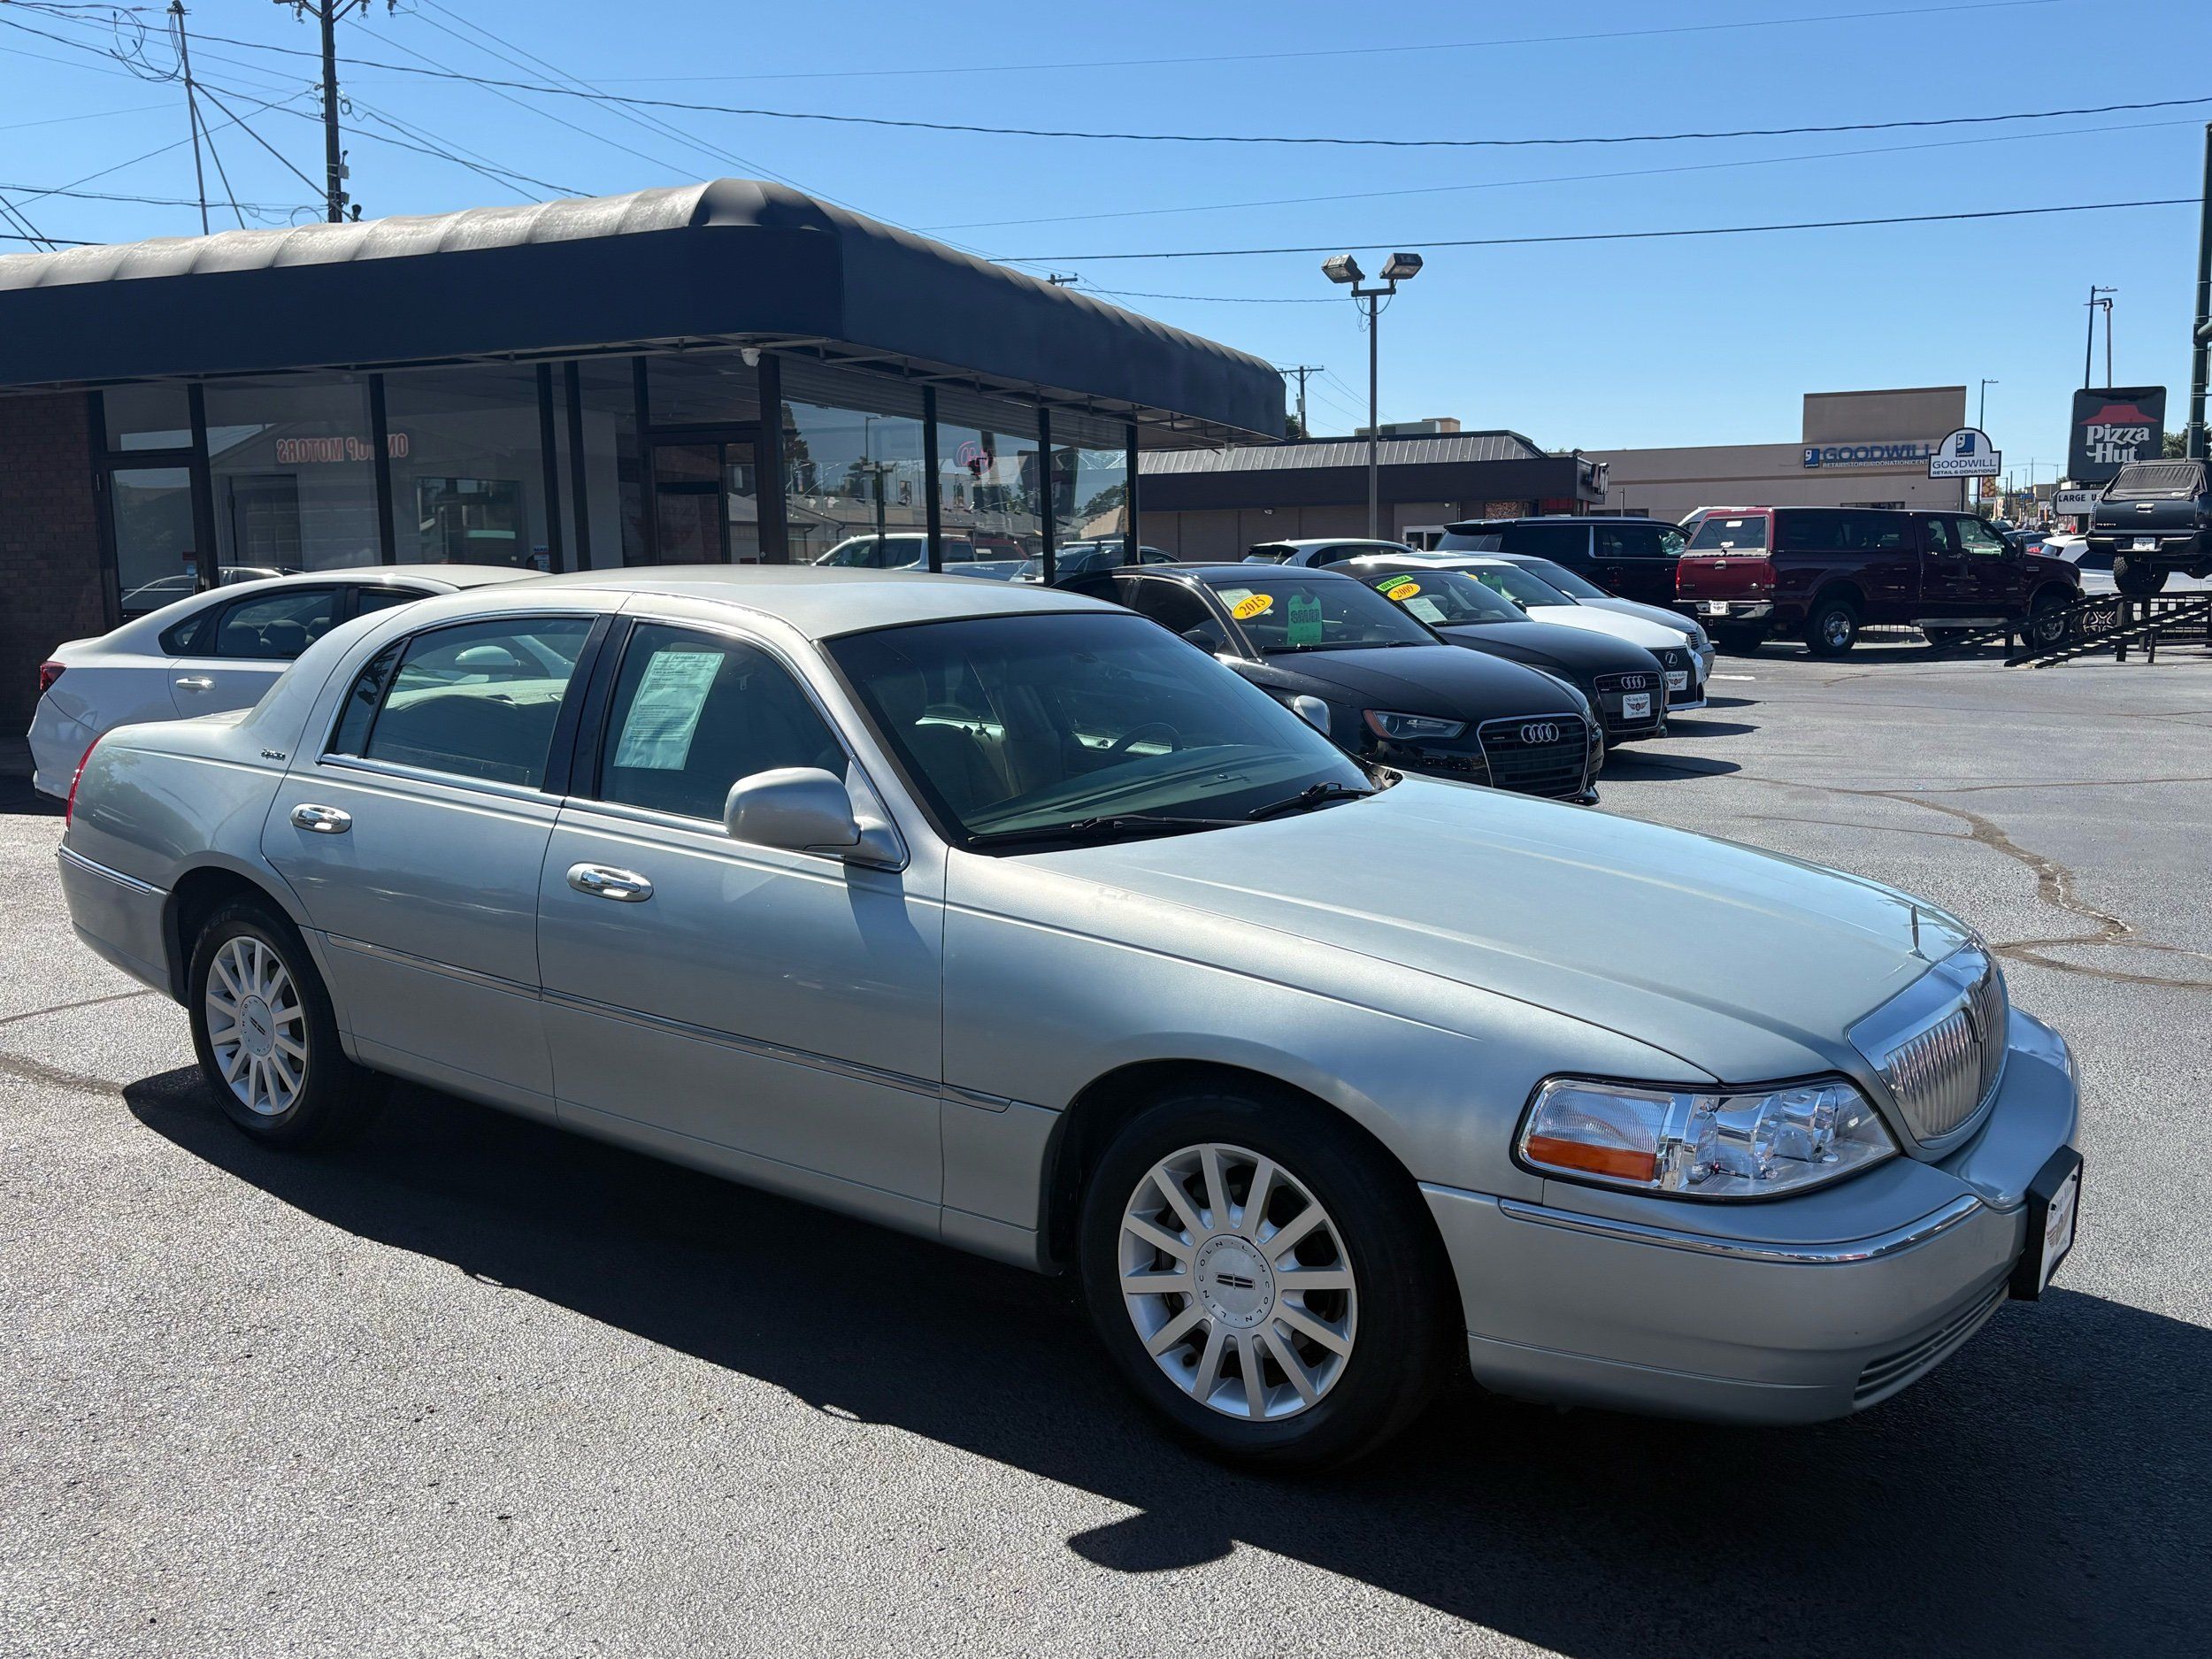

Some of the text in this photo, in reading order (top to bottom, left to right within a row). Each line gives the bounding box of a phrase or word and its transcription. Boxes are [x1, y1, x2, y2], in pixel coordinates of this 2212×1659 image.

[2086, 424, 2150, 445] Pizza
[2086, 443, 2138, 463] Hut
[1932, 459, 1996, 469] GOODWILL
[1394, 585, 1414, 598] 2009
[1239, 595, 1266, 616] 2015
